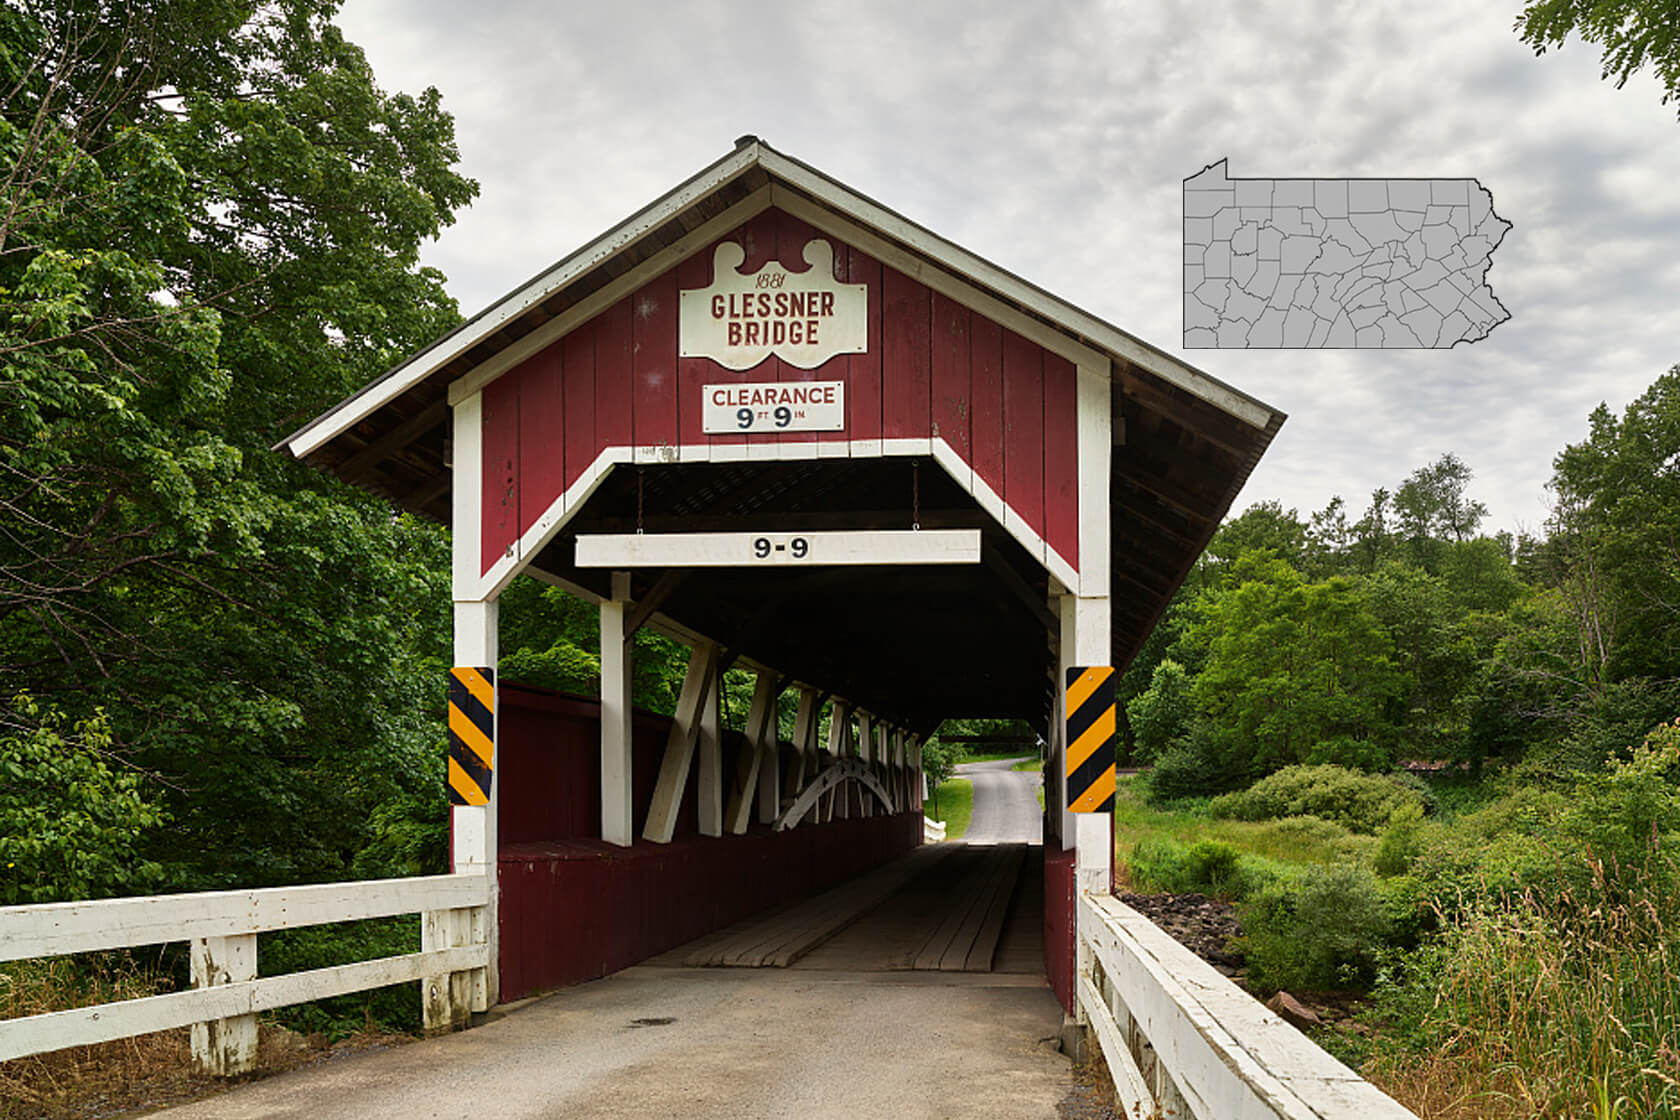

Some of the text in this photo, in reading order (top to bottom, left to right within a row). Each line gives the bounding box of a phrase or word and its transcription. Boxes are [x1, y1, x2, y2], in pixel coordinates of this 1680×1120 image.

[755, 273, 787, 289] 1881
[711, 291, 835, 319] GLESSNER
[727, 320, 819, 346] BRIDGE
[712, 387, 835, 406] CLEARANCE
[736, 406, 806, 429] 9 FT 9 IN
[754, 537, 809, 559] 9-9
